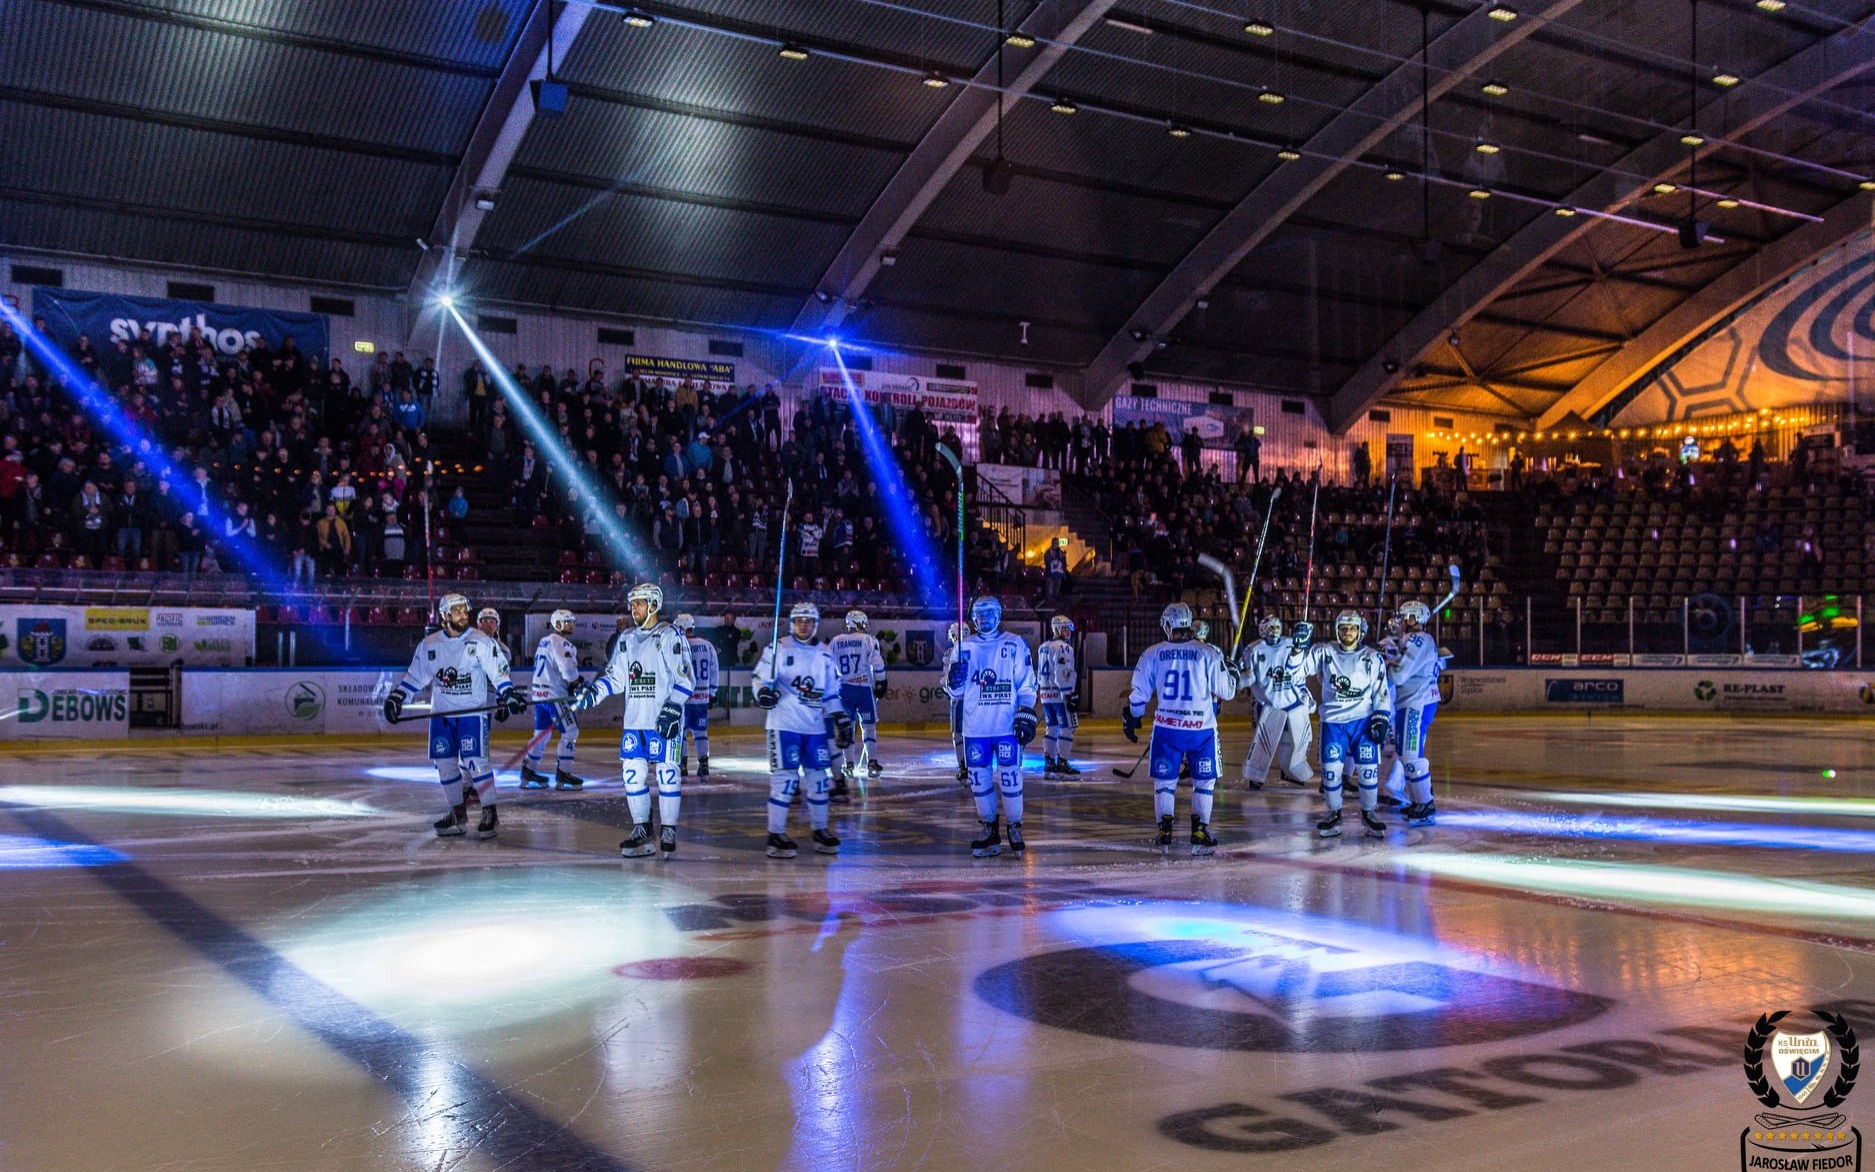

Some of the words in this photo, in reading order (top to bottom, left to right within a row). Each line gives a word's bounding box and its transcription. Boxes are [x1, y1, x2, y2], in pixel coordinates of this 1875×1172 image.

[627, 357, 655, 366] FIRMA
[657, 359, 707, 371] HANDLOWA
[709, 365, 733, 373] "ABA"
[1115, 397, 1137, 409] GAZY
[1141, 399, 1192, 415] TECHNICZNE
[1001, 647, 1007, 659] C
[1060, 644, 1070, 653] 14
[1160, 649, 1197, 661] OREKHIN
[692, 659, 708, 680] 18
[839, 654, 861, 675] 87
[1163, 670, 1192, 701] 91
[1573, 681, 1618, 691] arco
[1724, 684, 1786, 693] RE-PLAST
[658, 769, 676, 784] 12
[1001, 771, 1019, 787] 61
